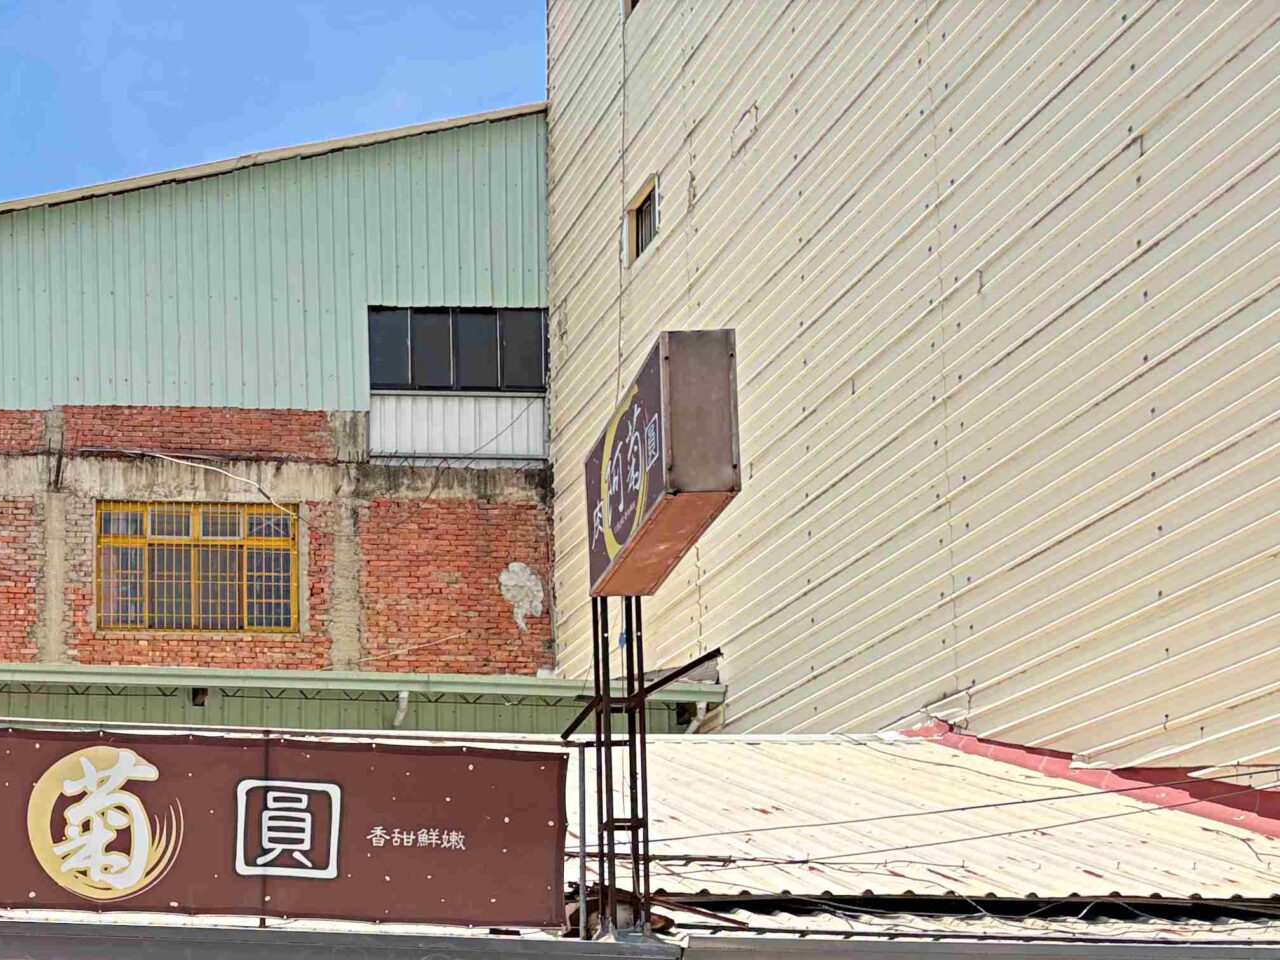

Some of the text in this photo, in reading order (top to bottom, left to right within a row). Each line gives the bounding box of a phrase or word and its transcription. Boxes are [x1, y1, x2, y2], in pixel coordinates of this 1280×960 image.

[235, 778, 342, 880] 圓
[366, 825, 467, 851] 香甜鮮嫩
